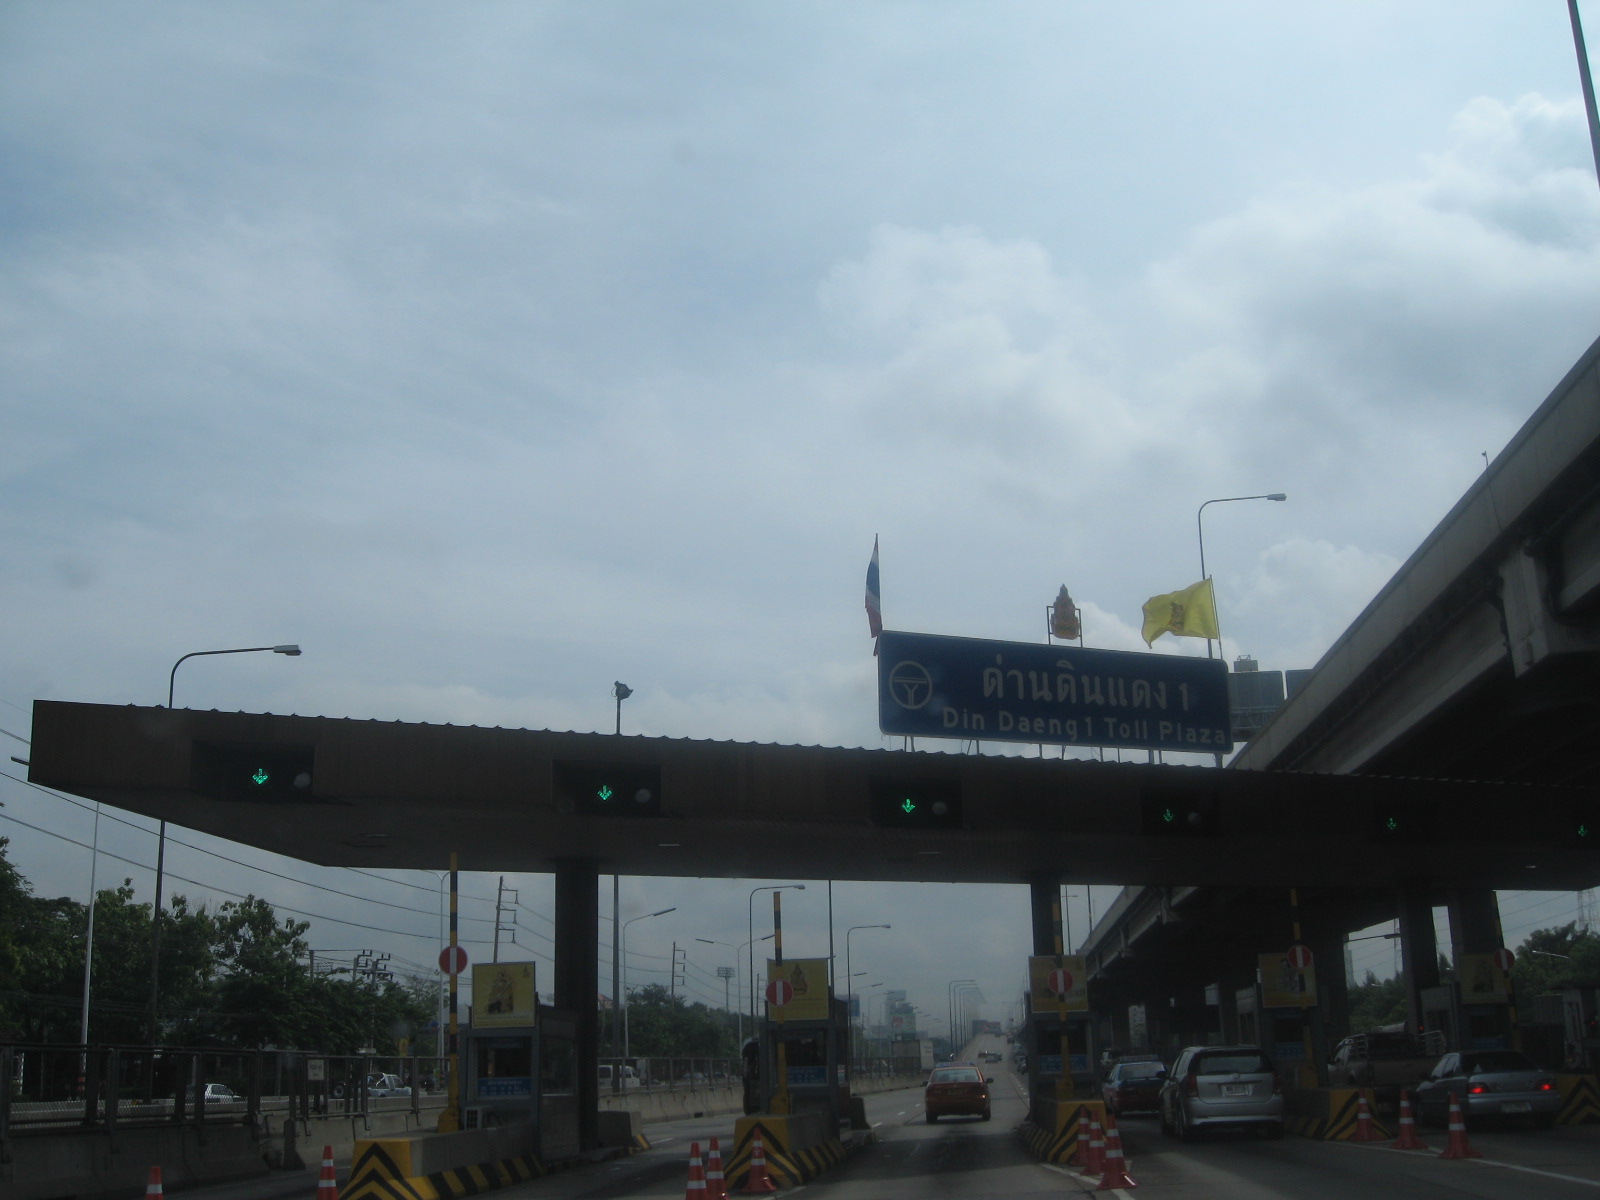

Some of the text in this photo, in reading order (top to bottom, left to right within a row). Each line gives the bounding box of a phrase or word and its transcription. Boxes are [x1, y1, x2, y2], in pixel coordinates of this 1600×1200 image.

[982, 655, 1168, 710] ด่านดินแดง
[943, 707, 985, 731] Din
[1104, 717, 1147, 740] Toll
[1160, 722, 1226, 745] Plaza
